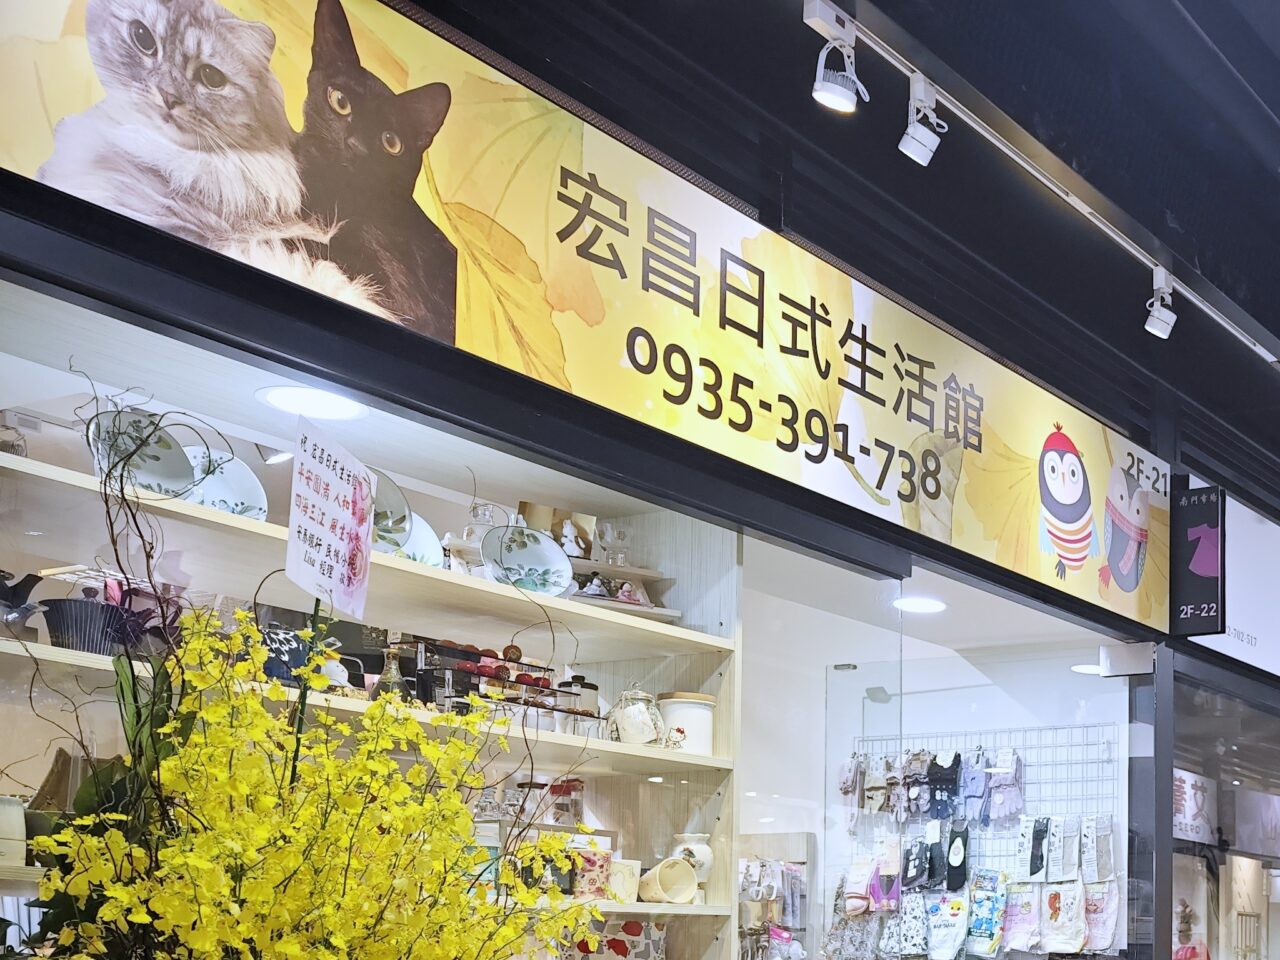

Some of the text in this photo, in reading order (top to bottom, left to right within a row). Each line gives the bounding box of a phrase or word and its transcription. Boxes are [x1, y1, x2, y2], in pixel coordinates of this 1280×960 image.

[557, 164, 985, 454] 宏昌日式生活館
[625, 327, 942, 502] 0935-391-738
[1126, 451, 1169, 498] 2F-21
[1179, 603, 1217, 618] 2F-22
